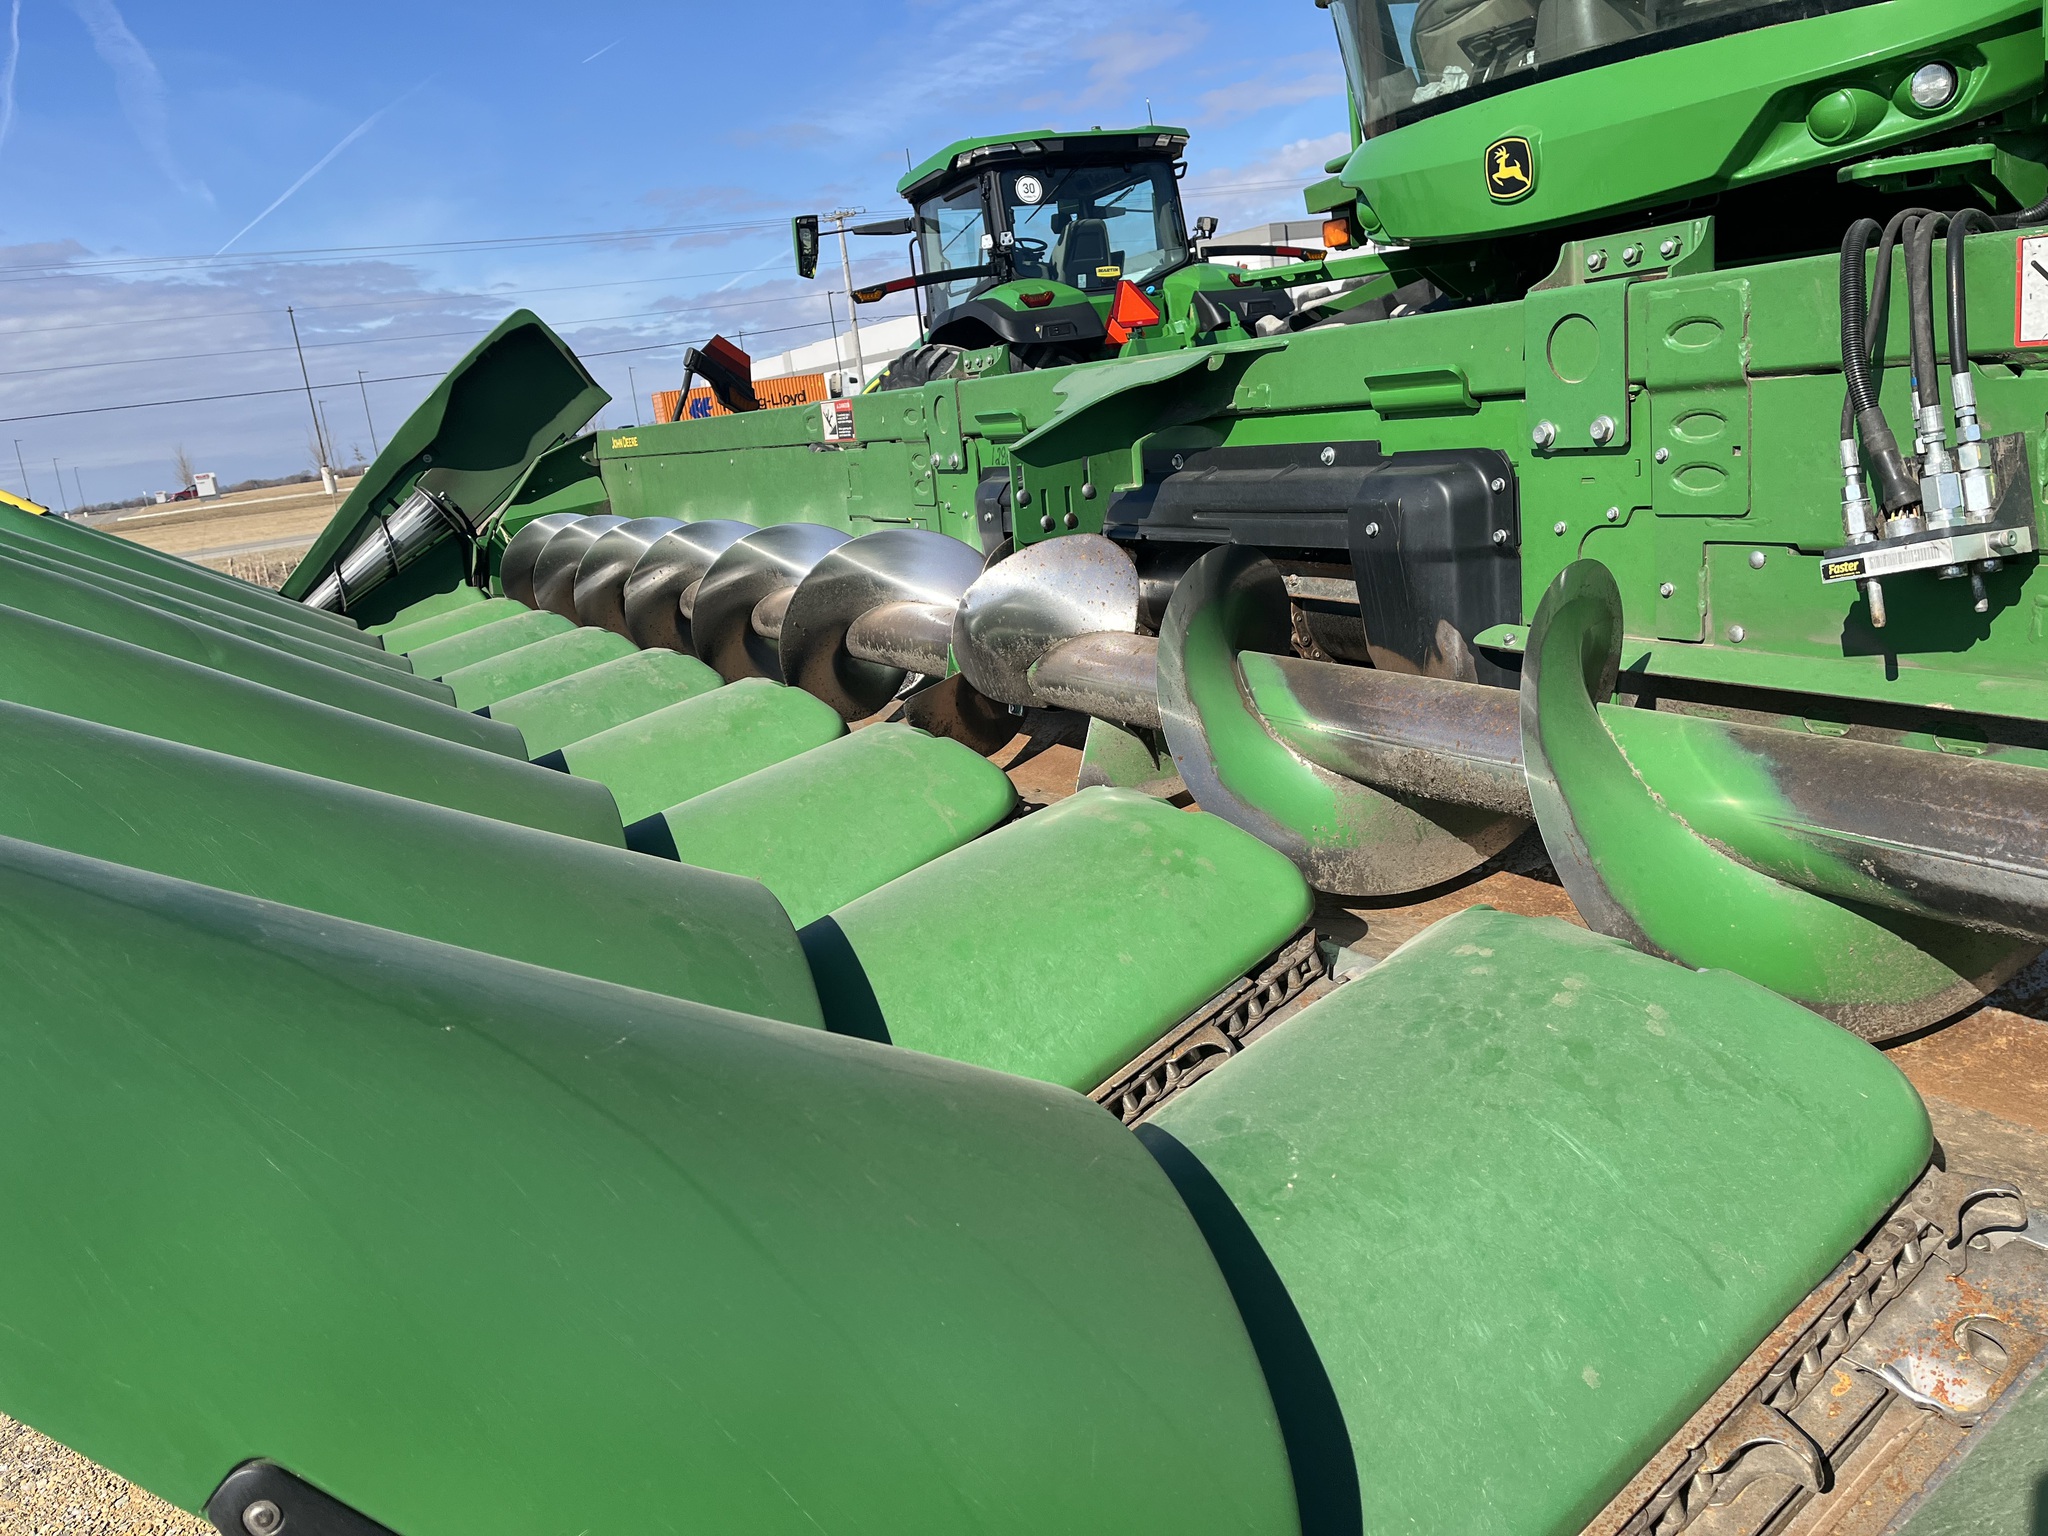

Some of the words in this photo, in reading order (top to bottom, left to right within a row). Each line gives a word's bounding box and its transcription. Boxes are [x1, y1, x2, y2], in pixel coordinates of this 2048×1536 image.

[1023, 183, 1035, 193] 30
[611, 436, 623, 449] JOHN
[622, 436, 638, 447] DEERE
[1829, 561, 1859, 575] Faster
